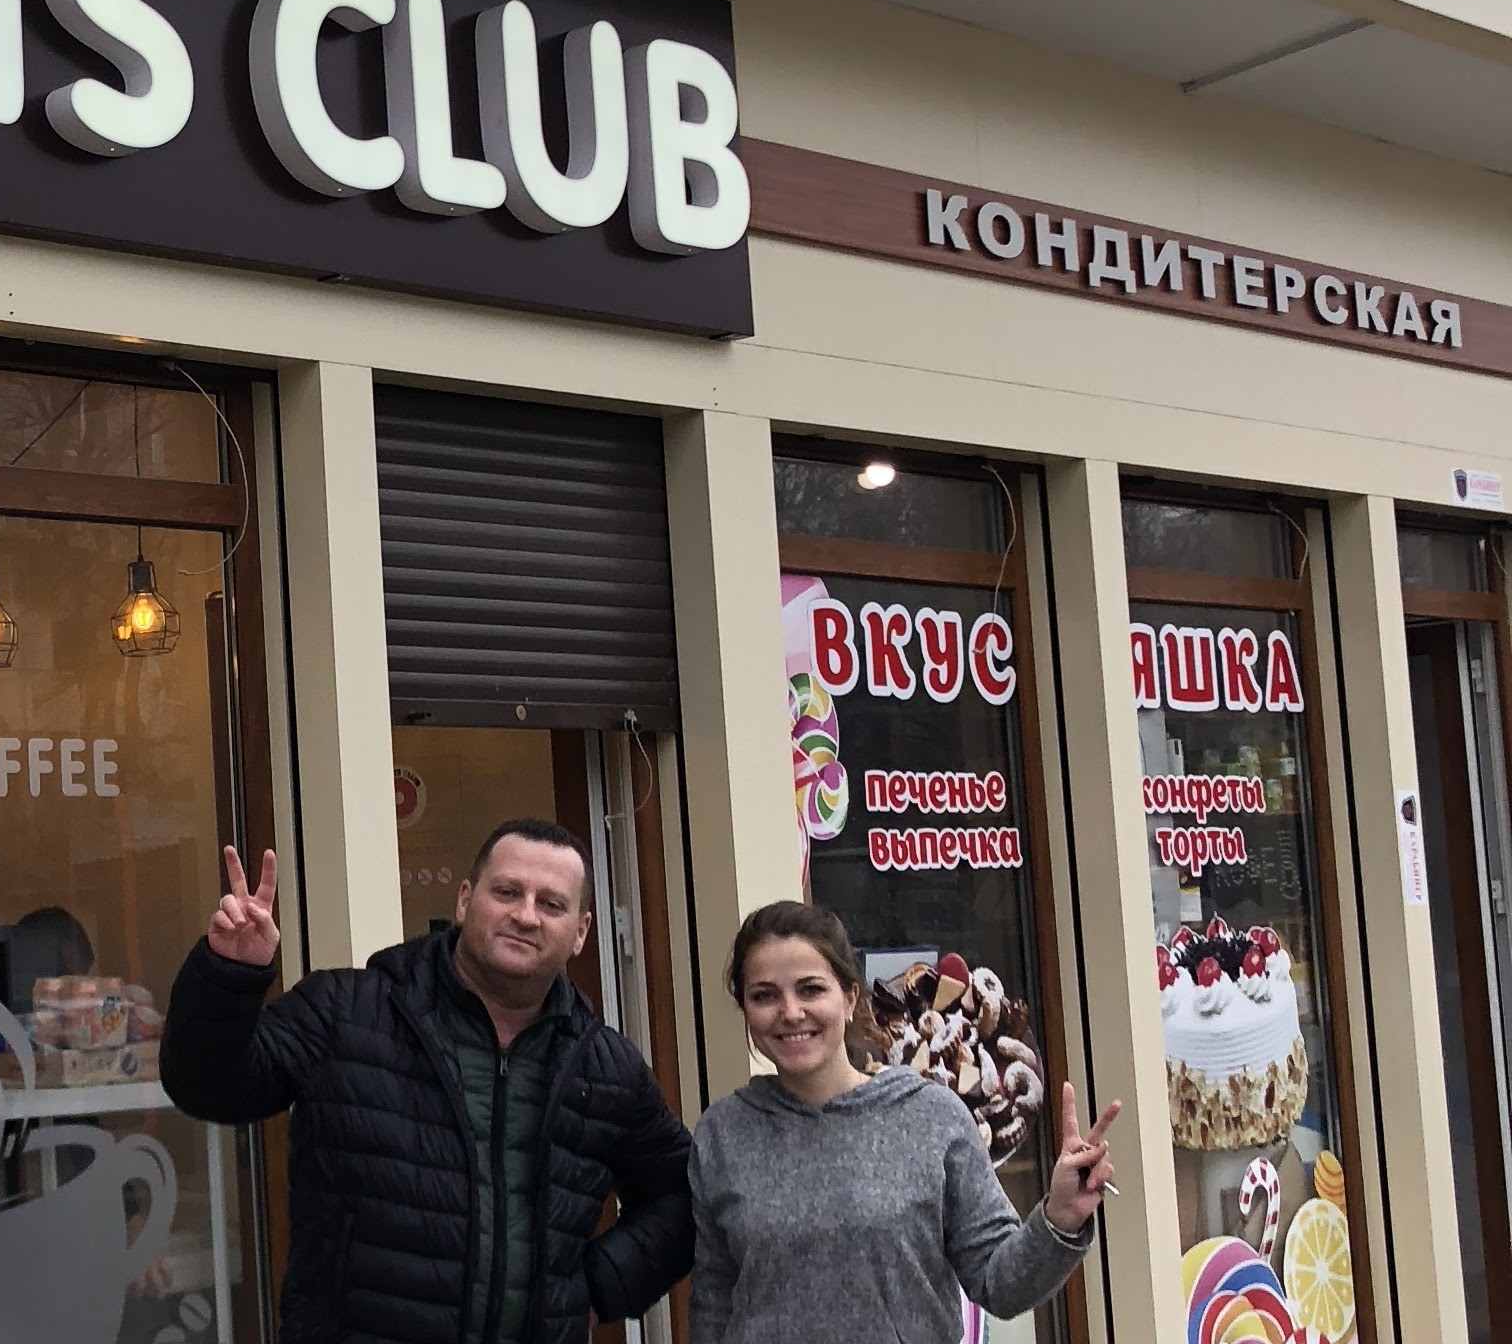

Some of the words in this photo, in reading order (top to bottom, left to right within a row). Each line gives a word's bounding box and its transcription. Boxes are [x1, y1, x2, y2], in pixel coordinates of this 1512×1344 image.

[926, 188, 1464, 349] КОНДИТЕРСКАЯ
[810, 601, 1015, 702] ВКУС
[867, 771, 1005, 812] печенье
[870, 829, 1021, 869] выпечка
[1157, 829, 1247, 874] торты
